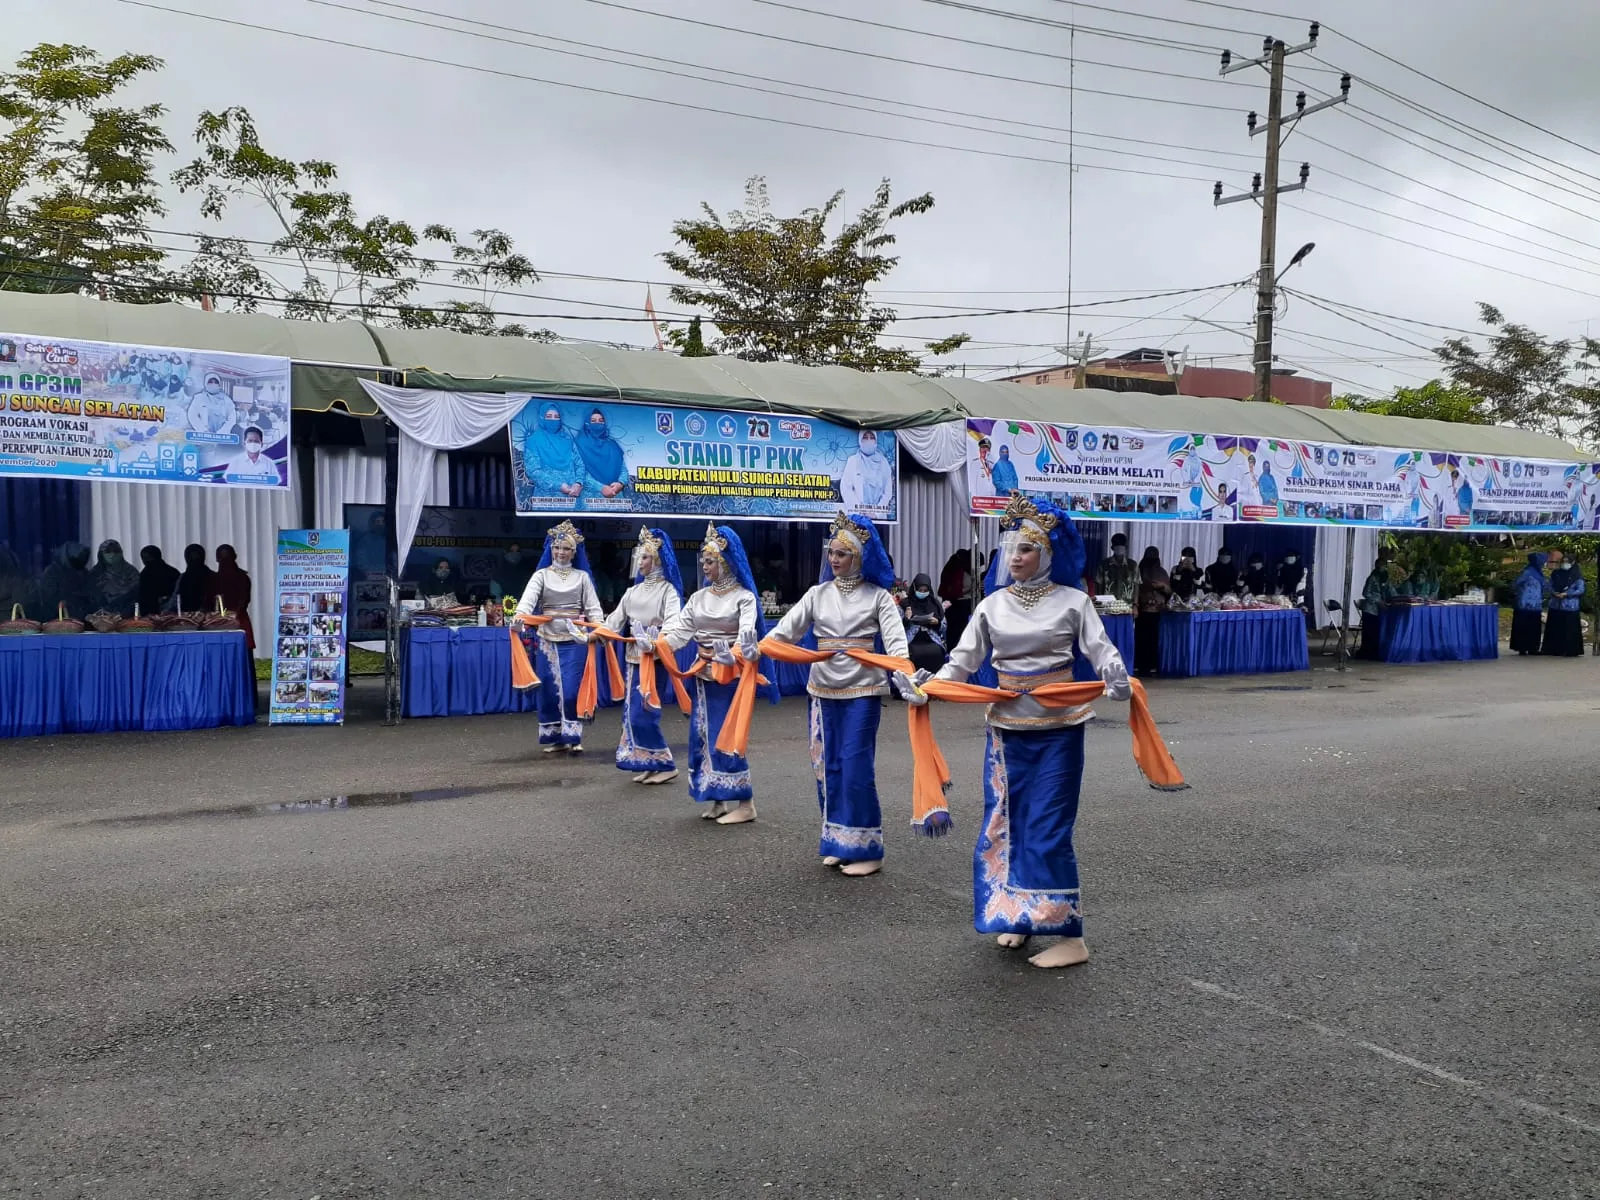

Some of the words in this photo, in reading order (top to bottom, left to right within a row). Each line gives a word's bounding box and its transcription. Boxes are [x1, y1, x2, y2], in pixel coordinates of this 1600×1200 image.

[26, 343, 61, 354] Sehti
[20, 374, 81, 395] GP3M
[10, 393, 81, 416] SUNGAI
[84, 399, 165, 423] SELATAN
[49, 420, 88, 432] VOKASI
[3, 430, 21, 439] DAN
[23, 431, 65, 441] MEMBUAT
[67, 433, 88, 443] KUE)
[2, 443, 58, 455] PEREMPUAN
[60, 446, 91, 457] TAHUN
[93, 448, 113, 459] 2020
[666, 440, 733, 468] STAND
[737, 444, 761, 469] TP
[765, 446, 804, 471] PKK
[637, 467, 708, 482] KABUPATEN
[709, 470, 740, 484] HULU
[741, 471, 785, 486] SUNGAI
[786, 474, 831, 488] SELATAN
[1043, 463, 1082, 475] STAND
[1085, 466, 1119, 476] PKBM
[1121, 467, 1164, 479] MELATI
[635, 483, 672, 493] PROGRAM
[672, 484, 720, 495] PENINGKATAN
[720, 486, 752, 497] KUALITAS
[753, 487, 775, 497] HIDUP
[775, 489, 813, 499] PEREMPUAN
[1286, 476, 1317, 487] STAND
[1318, 478, 1345, 489] PKBM
[1347, 480, 1374, 490] SINAR
[1376, 481, 1401, 492] DAHA
[1478, 487, 1502, 497] STAND
[1503, 488, 1524, 499] PKBM
[1549, 490, 1568, 500] AMIN
